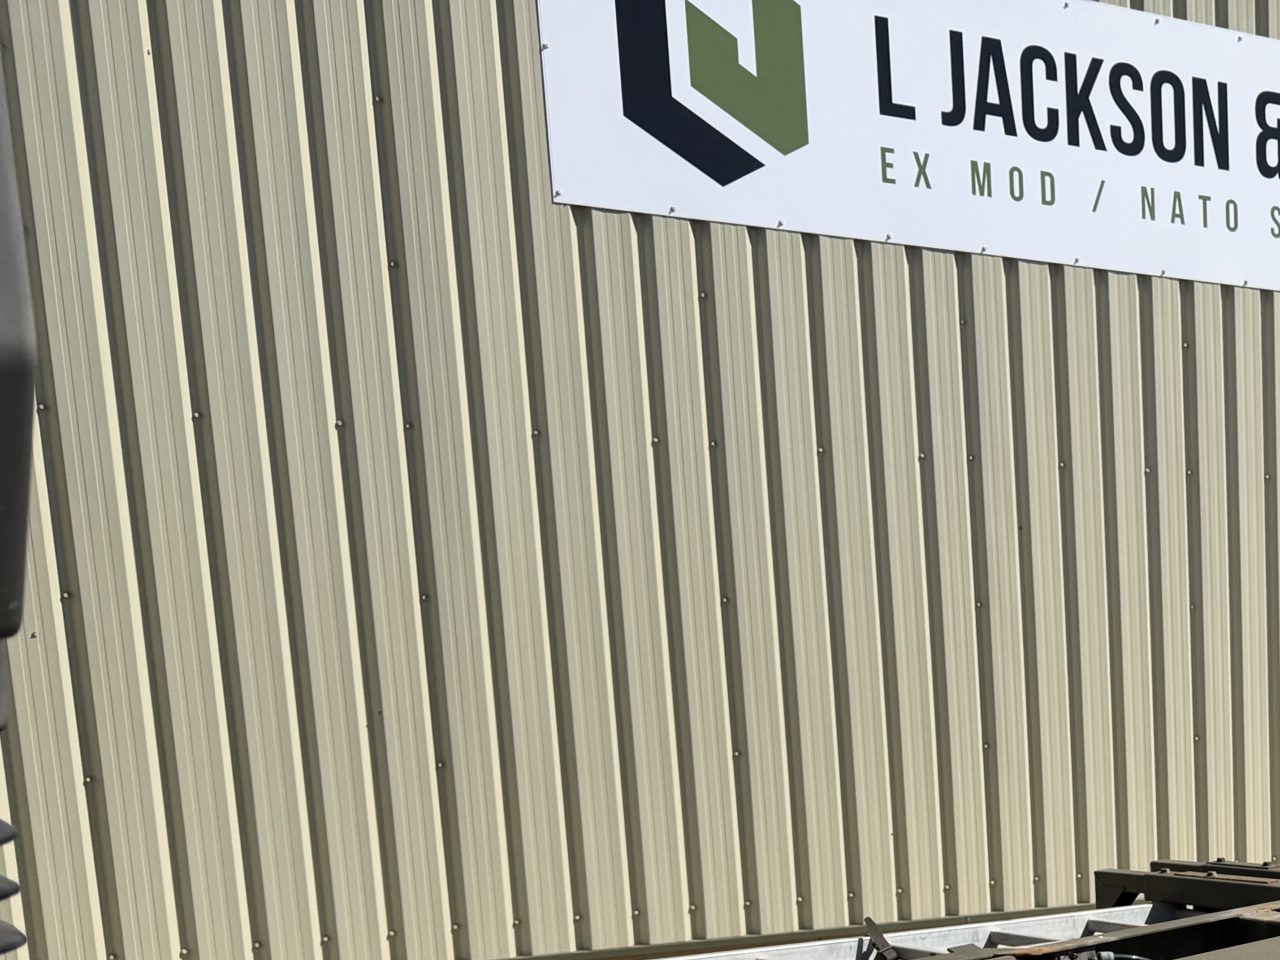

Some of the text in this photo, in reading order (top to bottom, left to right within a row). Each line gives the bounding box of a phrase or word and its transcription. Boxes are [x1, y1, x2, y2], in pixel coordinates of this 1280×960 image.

[874, 15, 916, 120] L
[941, 29, 1230, 171] JACKSON
[880, 146, 932, 189] EX
[970, 160, 1056, 207] MOD
[1092, 180, 1105, 212] /
[1140, 186, 1239, 232] NATO
